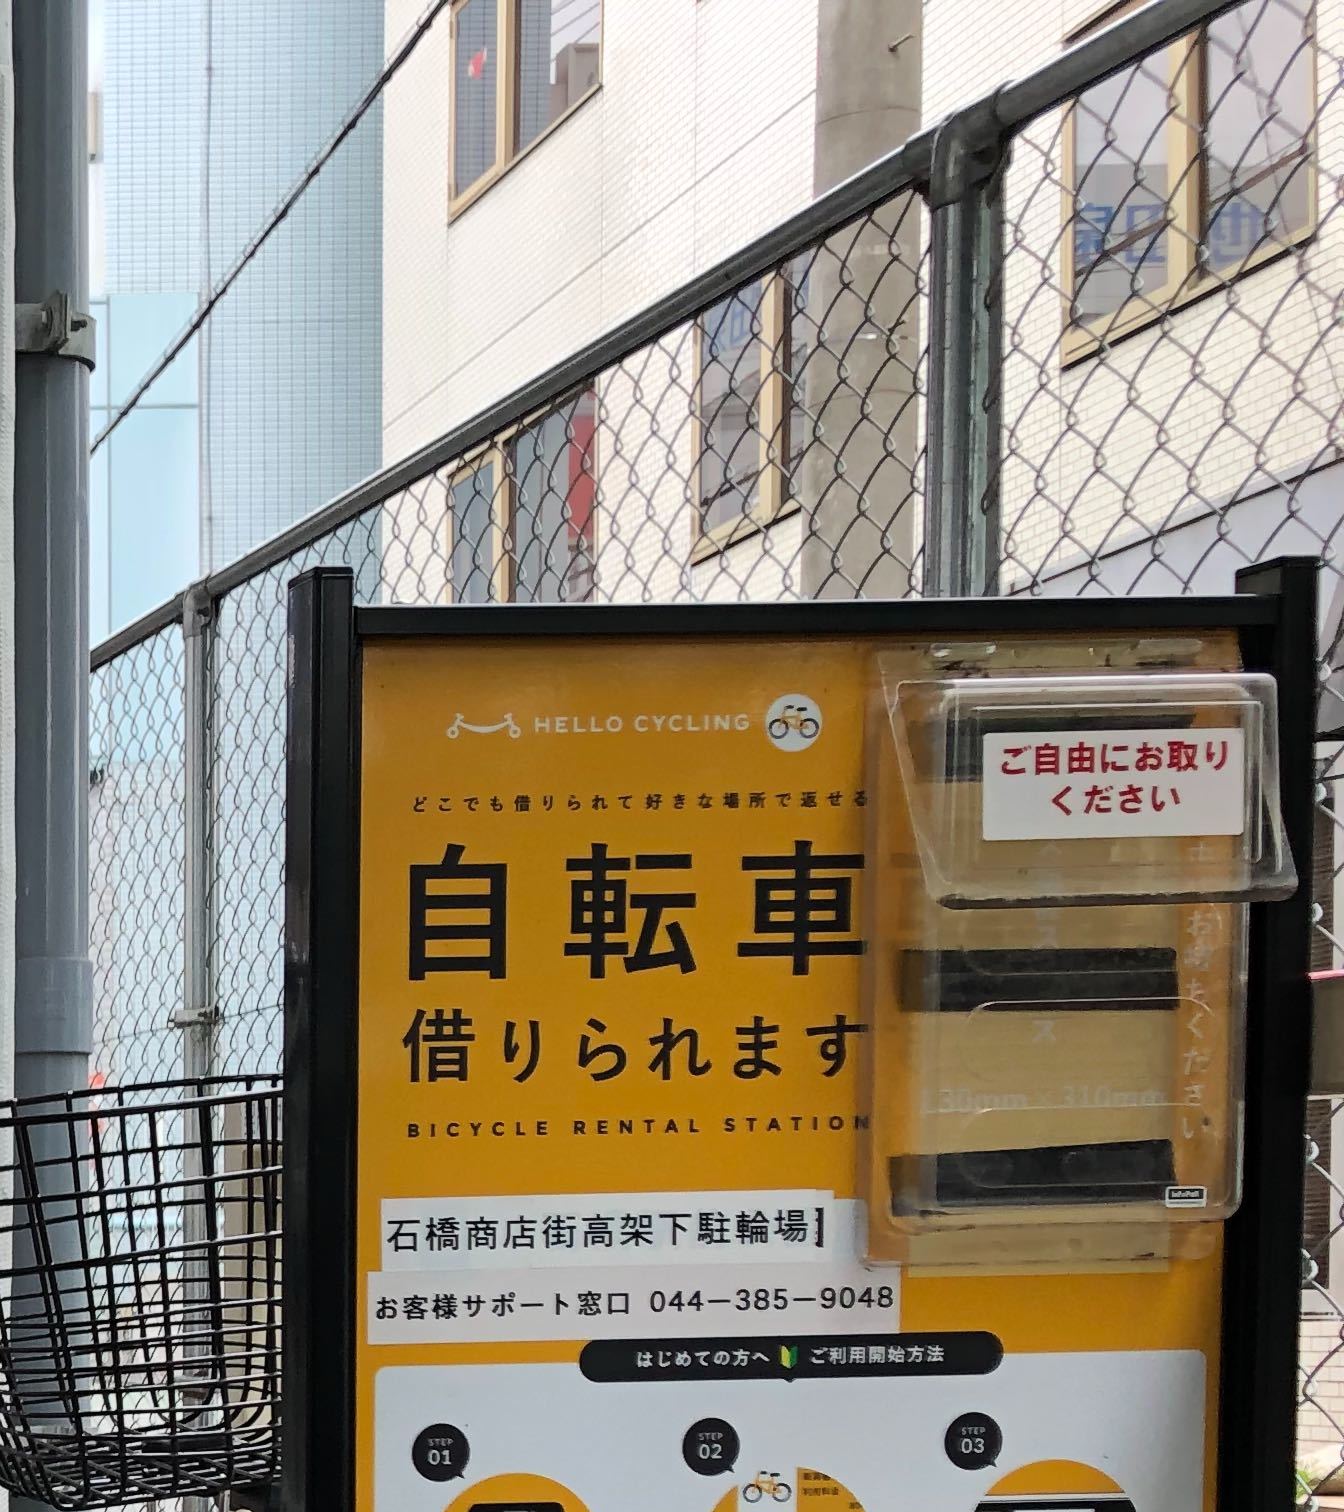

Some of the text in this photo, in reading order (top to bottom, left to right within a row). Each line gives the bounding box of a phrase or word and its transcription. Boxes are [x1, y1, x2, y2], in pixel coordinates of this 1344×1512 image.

[533, 713, 750, 734] HELLO CYCLING
[999, 740, 1230, 776] ご自由にお取り
[1051, 784, 1181, 817] ください
[408, 840, 866, 981] 自転車
[402, 1008, 869, 1083] 借りられます
[407, 1115, 870, 1138] BICYCLE RENTAL STATION
[375, 1289, 631, 1321] お客様サポート窓口
[636, 1345, 946, 1369] はじめての方へ ご利用開始方法
[427, 1437, 454, 1447] STEP
[698, 1432, 723, 1441] STEP
[961, 1426, 986, 1436] STEP
[698, 1443, 723, 1460] 02
[961, 1438, 985, 1454] 03
[427, 1449, 453, 1466] 01
